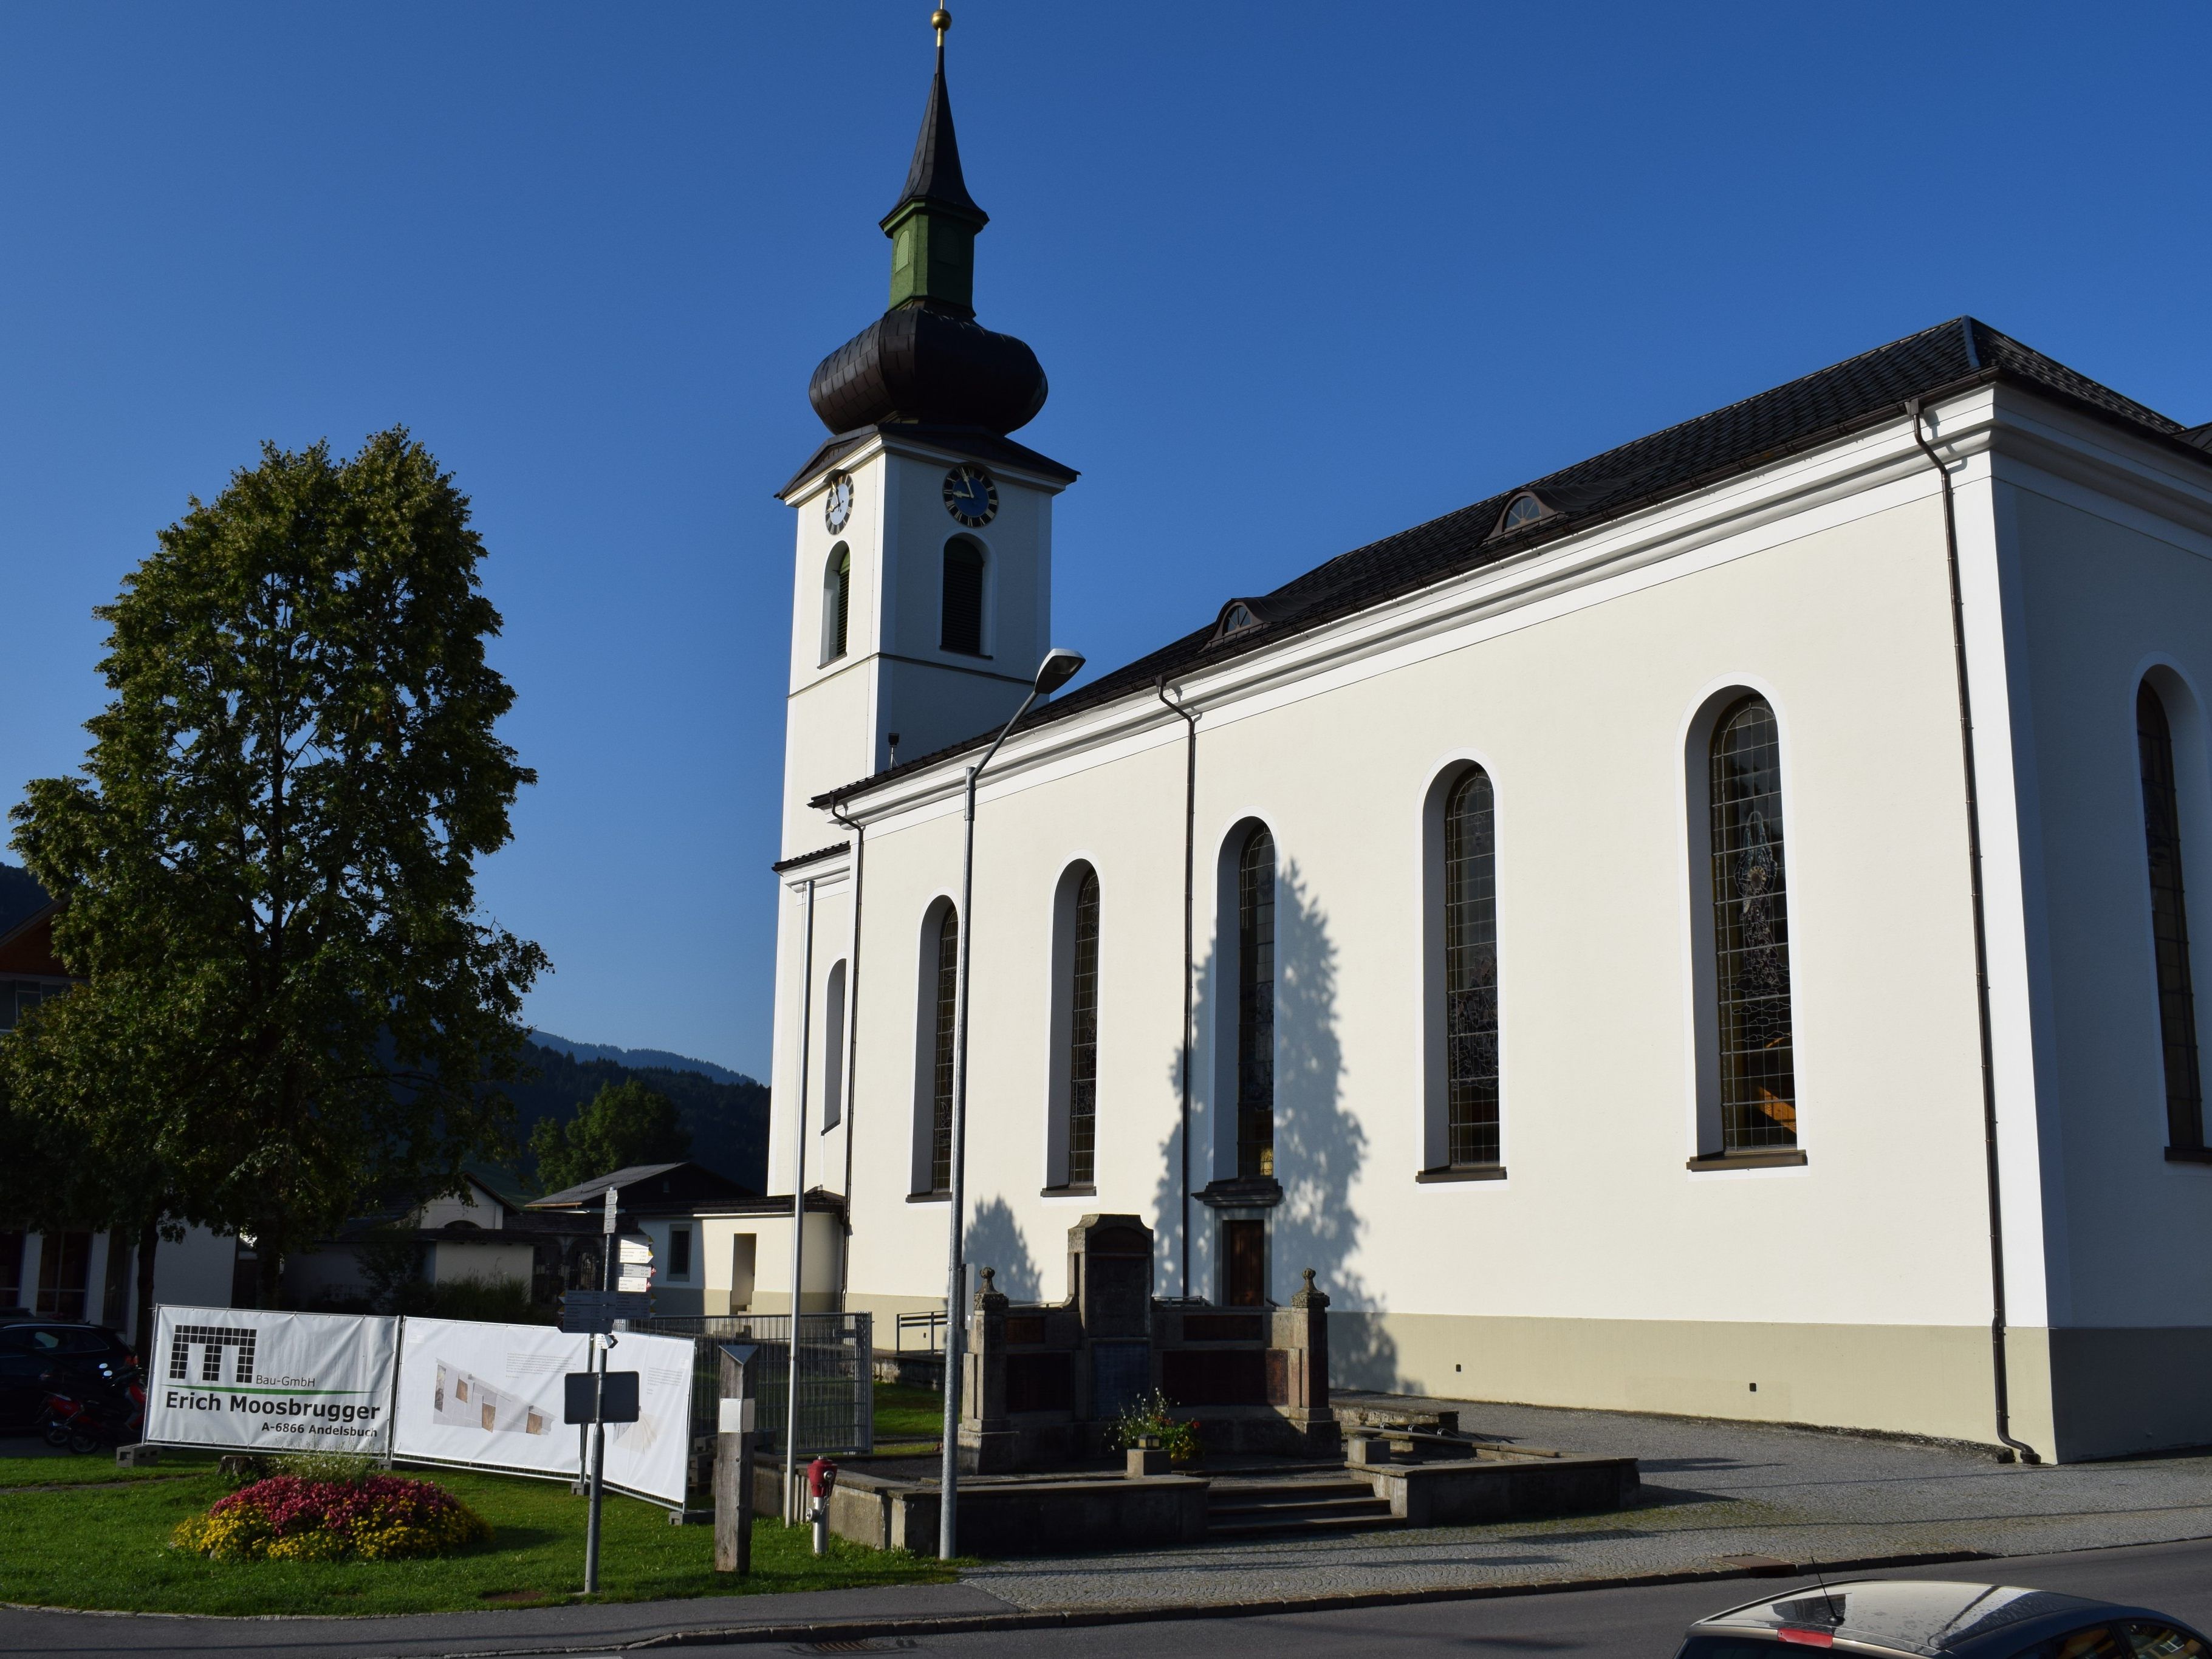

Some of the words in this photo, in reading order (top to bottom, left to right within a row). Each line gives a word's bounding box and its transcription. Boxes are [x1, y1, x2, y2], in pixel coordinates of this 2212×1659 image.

[256, 1375, 315, 1387] Bau-GmbH
[166, 1391, 221, 1412] Erich
[230, 1396, 380, 1422] Moosbrugger
[261, 1422, 304, 1434] A-6866
[309, 1425, 377, 1438] Andelsbuch
